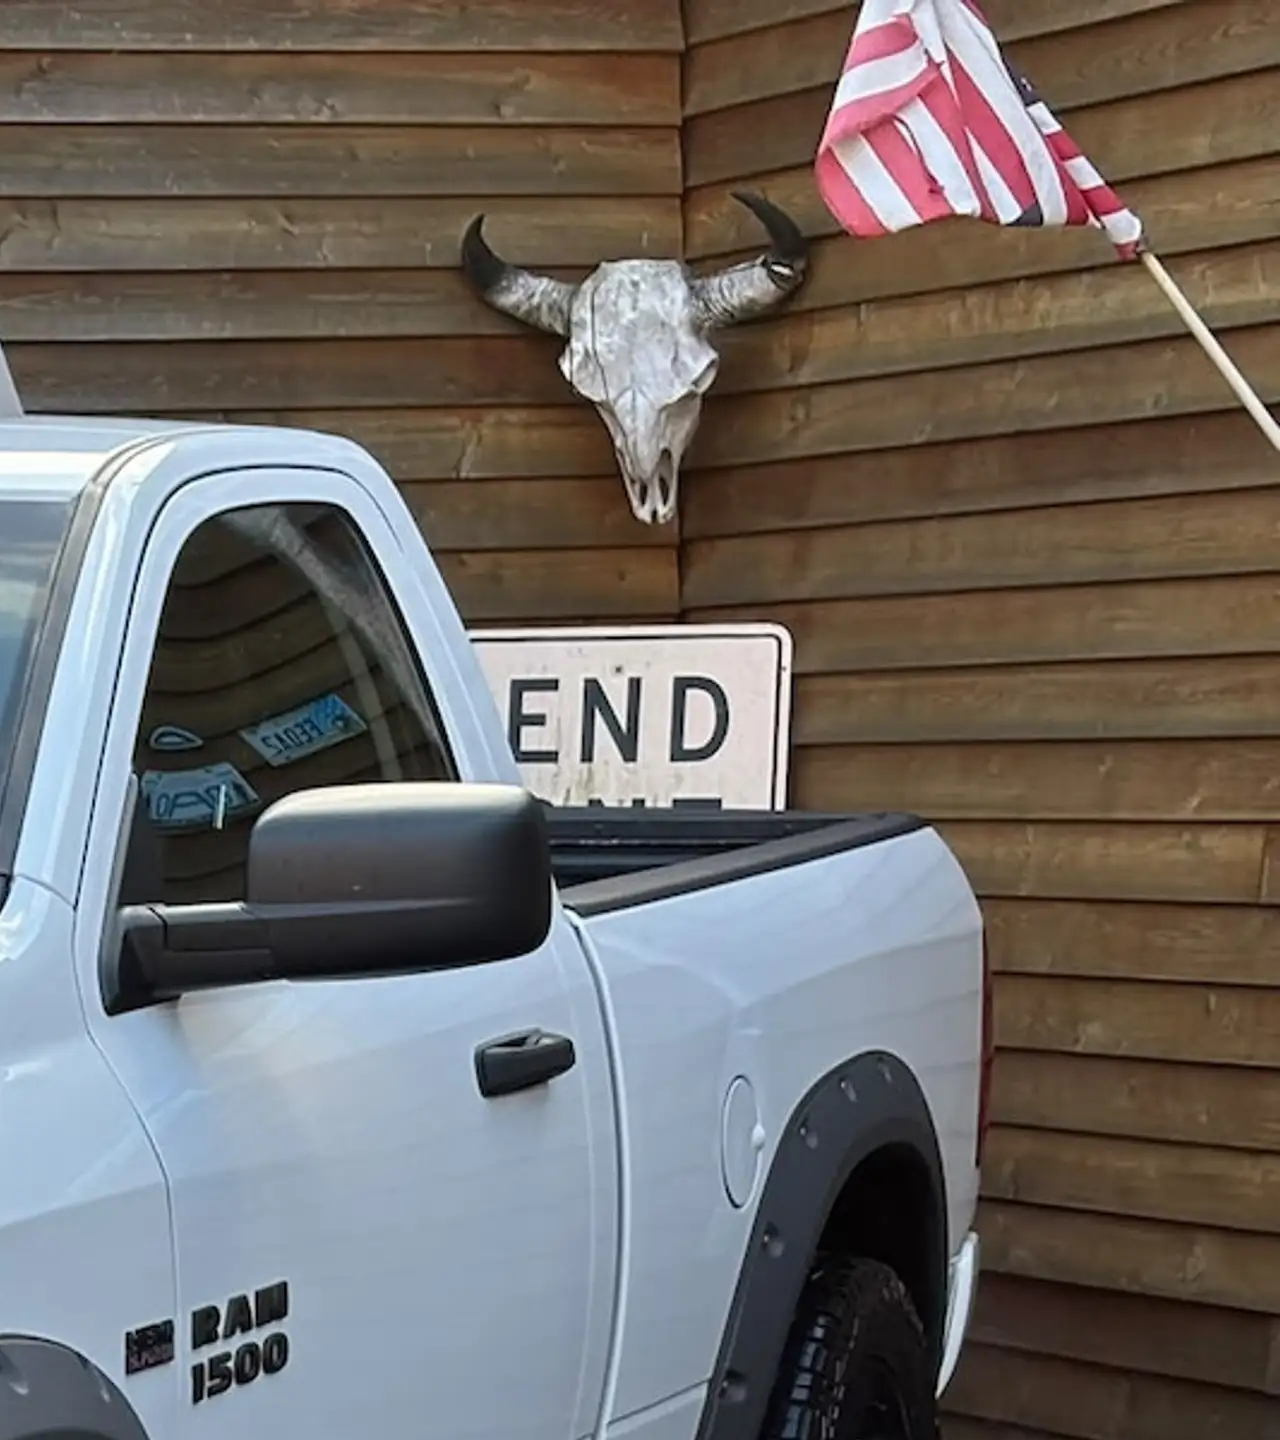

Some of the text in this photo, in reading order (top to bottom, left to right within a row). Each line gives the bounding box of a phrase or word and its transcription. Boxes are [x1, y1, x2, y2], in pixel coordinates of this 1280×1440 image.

[507, 676, 730, 764] END
[191, 1279, 289, 1351] RAM
[191, 1331, 289, 1406] 1500
